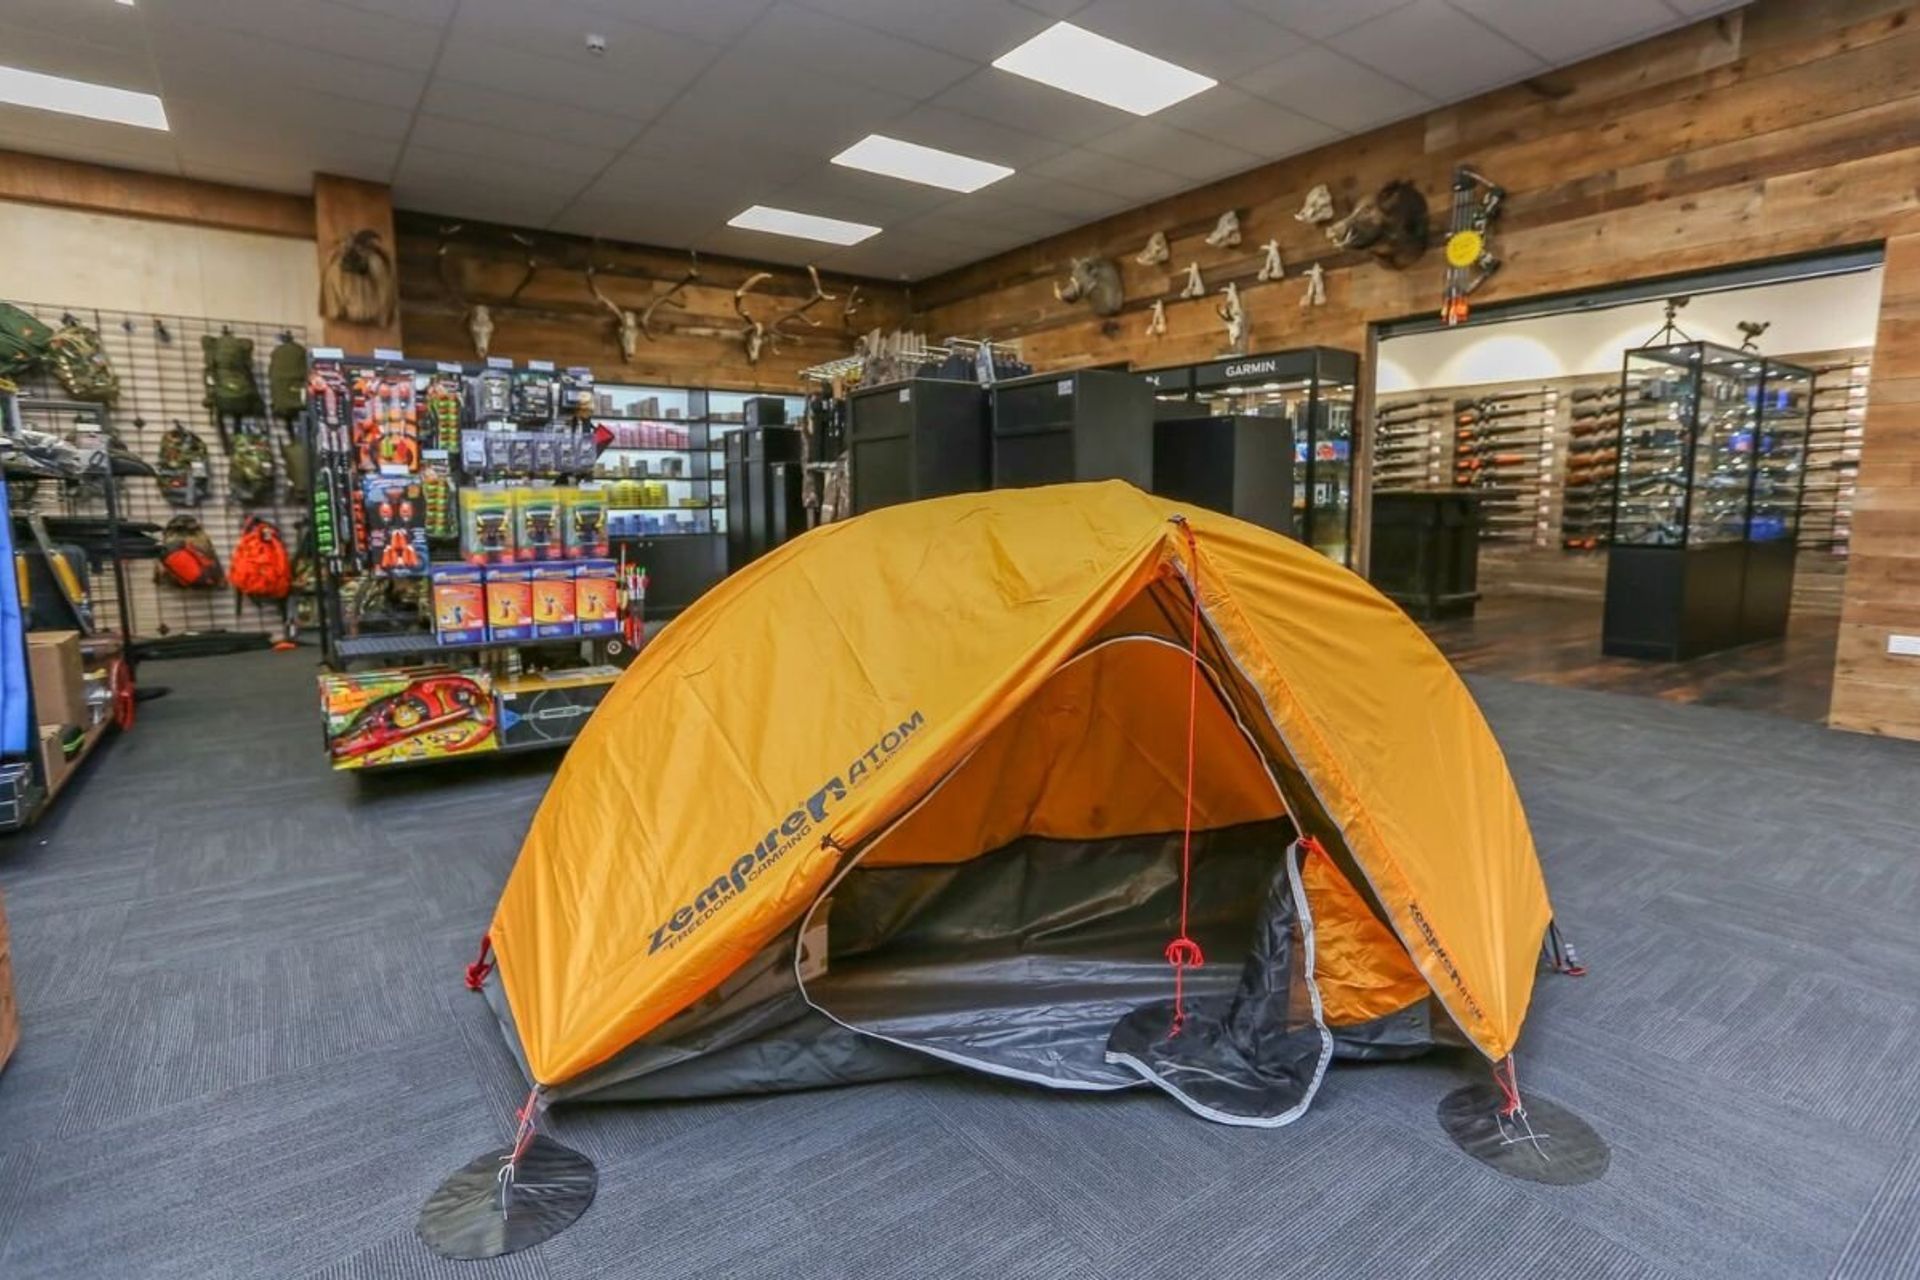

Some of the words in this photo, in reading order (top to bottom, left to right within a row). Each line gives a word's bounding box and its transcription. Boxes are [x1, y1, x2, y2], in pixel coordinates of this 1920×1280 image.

[1225, 360, 1276, 377] GARMIN
[849, 711, 924, 785] ATOM
[668, 889, 737, 950] FREEDOM
[748, 824, 812, 882] CAMPING
